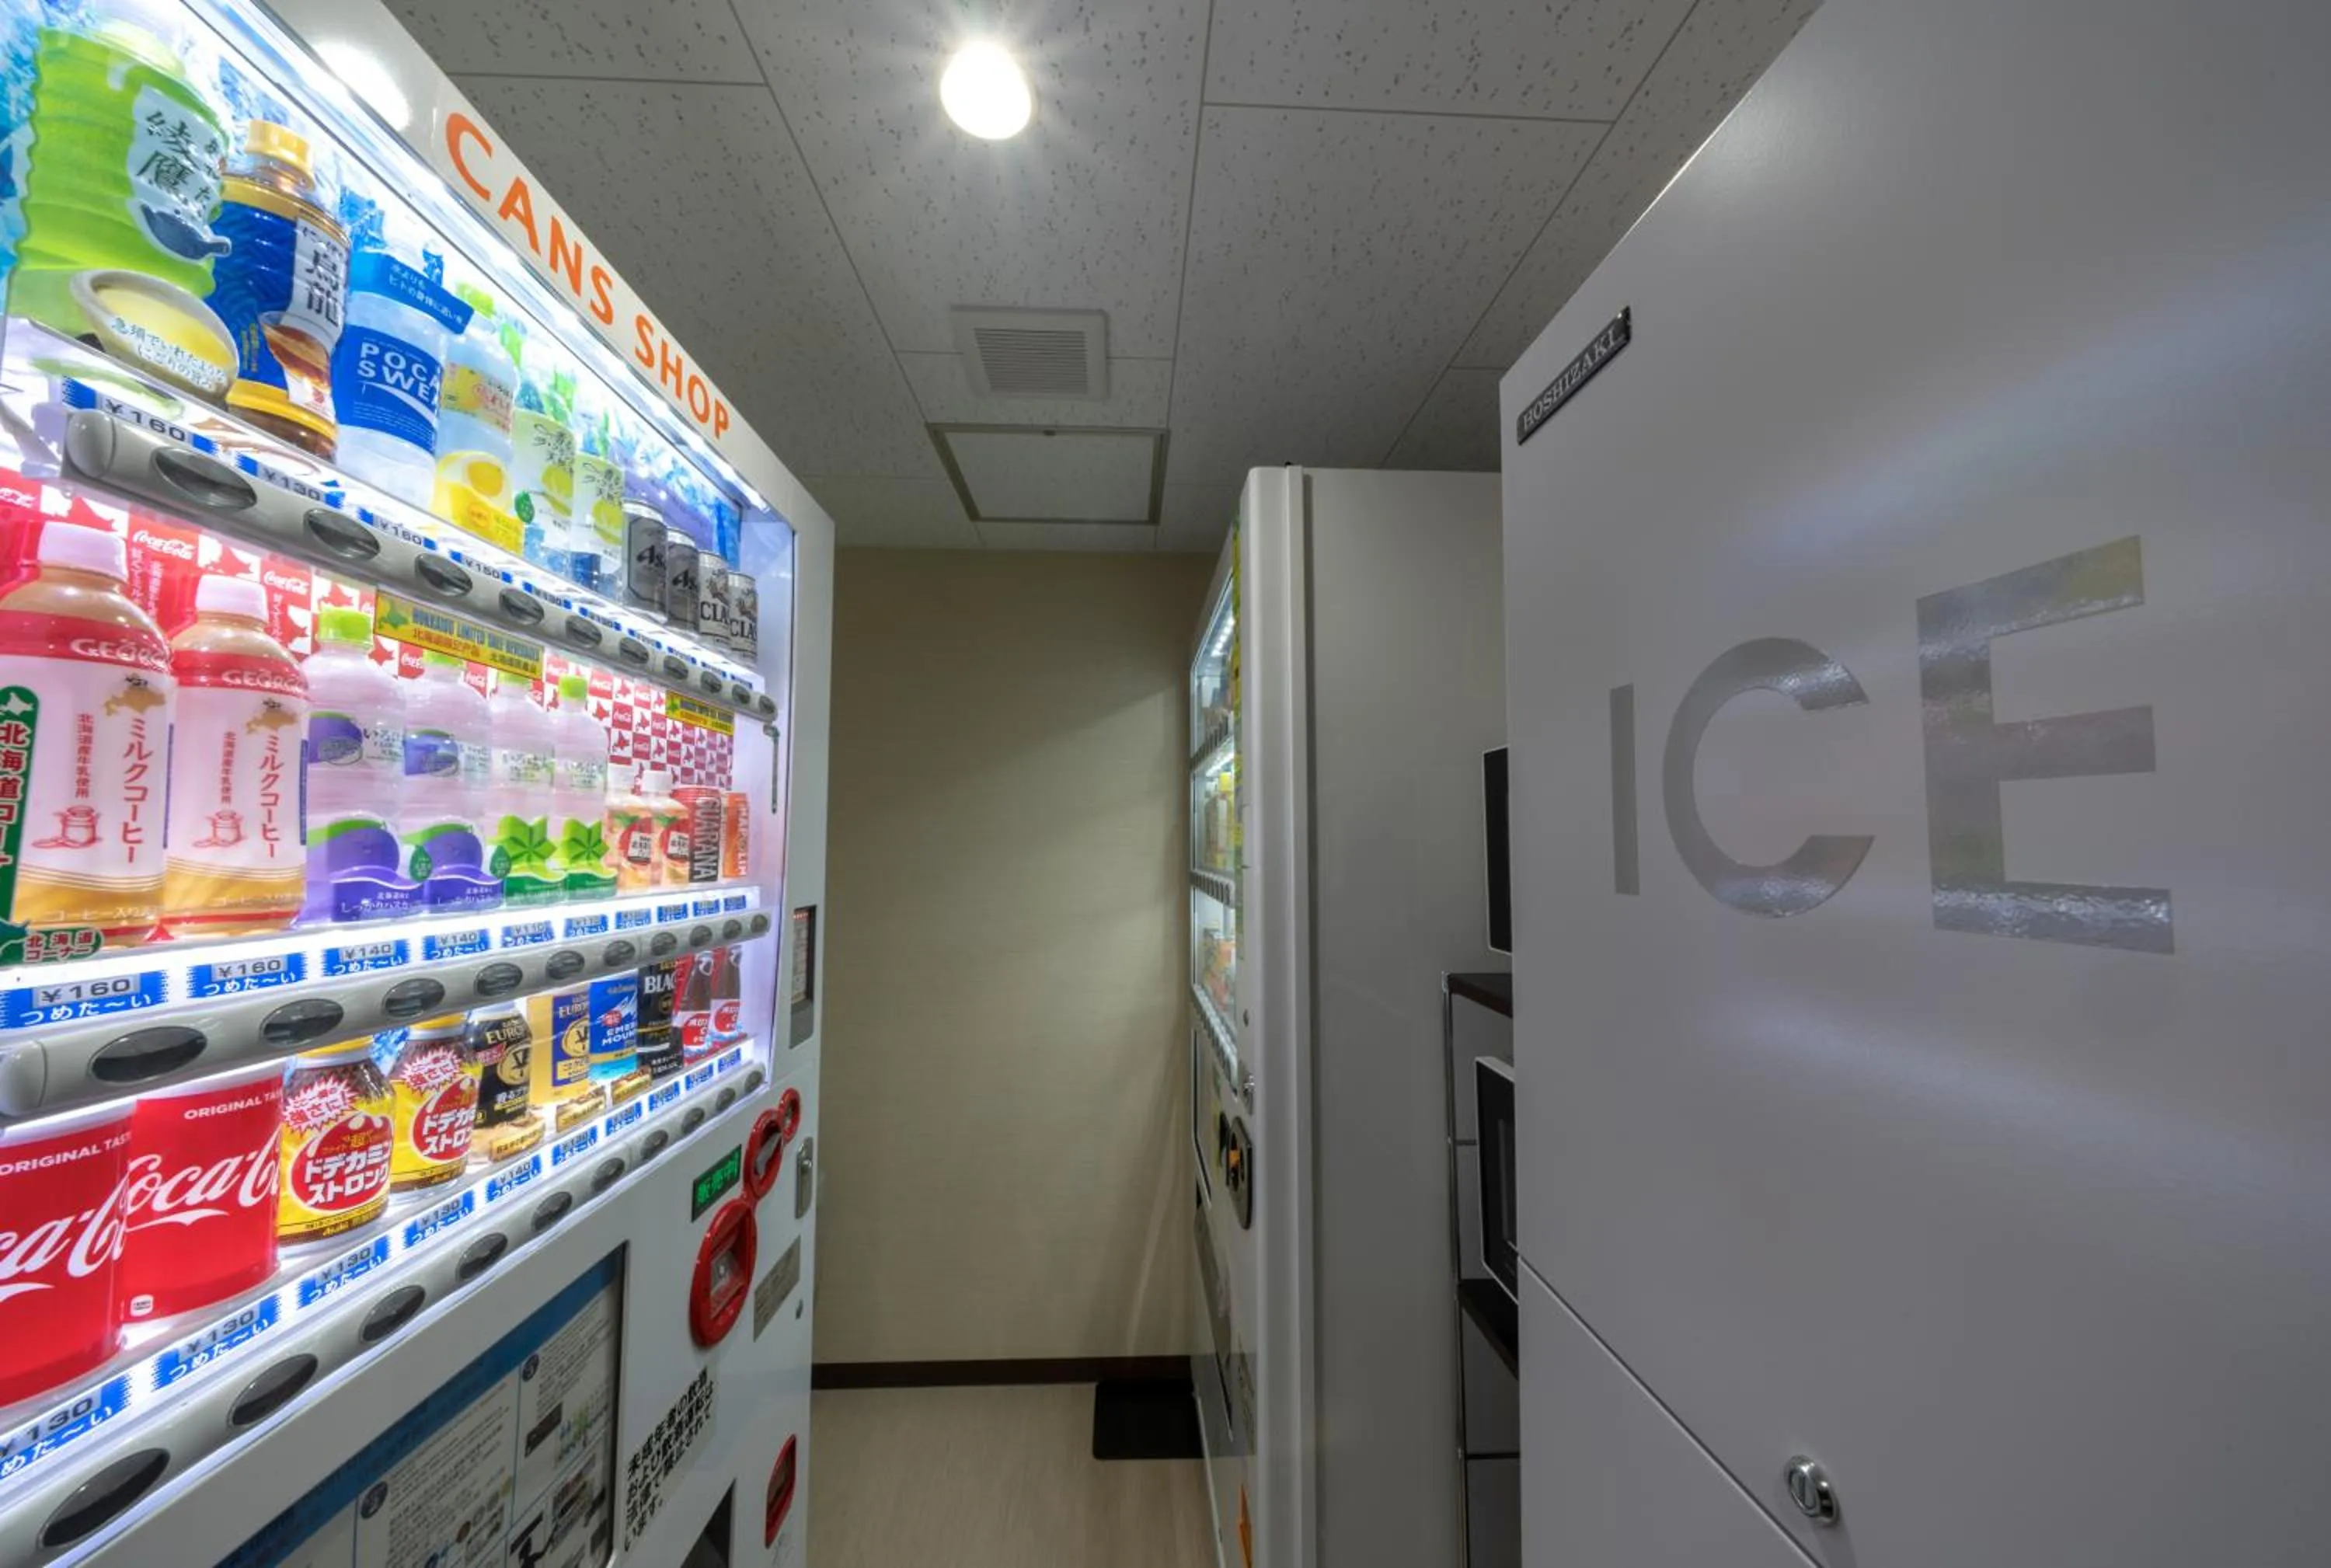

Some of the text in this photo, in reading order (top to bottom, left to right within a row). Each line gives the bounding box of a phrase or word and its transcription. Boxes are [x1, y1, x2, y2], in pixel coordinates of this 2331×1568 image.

[445, 112, 730, 441] CANS SHOP
[1523, 326, 1616, 431] HOSHIZAKI
[105, 398, 186, 442] ¥160
[264, 472, 321, 501] ¥130
[133, 529, 195, 560] Coca-Cola
[75, 713, 94, 799] 北海道産牛乳使用
[1610, 535, 2174, 954] ICE
[0, 723, 28, 866] 北海道コー
[121, 717, 153, 863] ミルクコーヒー
[259, 735, 285, 858] ミルクコーヒー
[694, 797, 721, 880] GUARANA
[26, 931, 93, 947] 北海道
[26, 946, 90, 961] コーナー
[344, 944, 392, 960] ¥140
[440, 932, 478, 945] ¥140
[218, 959, 282, 979] ¥160
[41, 978, 131, 1003] ¥160
[184, 1097, 263, 1120] ORIGINAL
[0, 1145, 100, 1176] ORIGINAL
[498, 1162, 531, 1185] ¥140
[305, 1163, 388, 1207] ストロング
[420, 1199, 461, 1225] ¥130
[322, 1247, 371, 1278] ¥130
[187, 1310, 255, 1354] ¥130
[628, 1366, 708, 1479] 未成年者の飲酒
